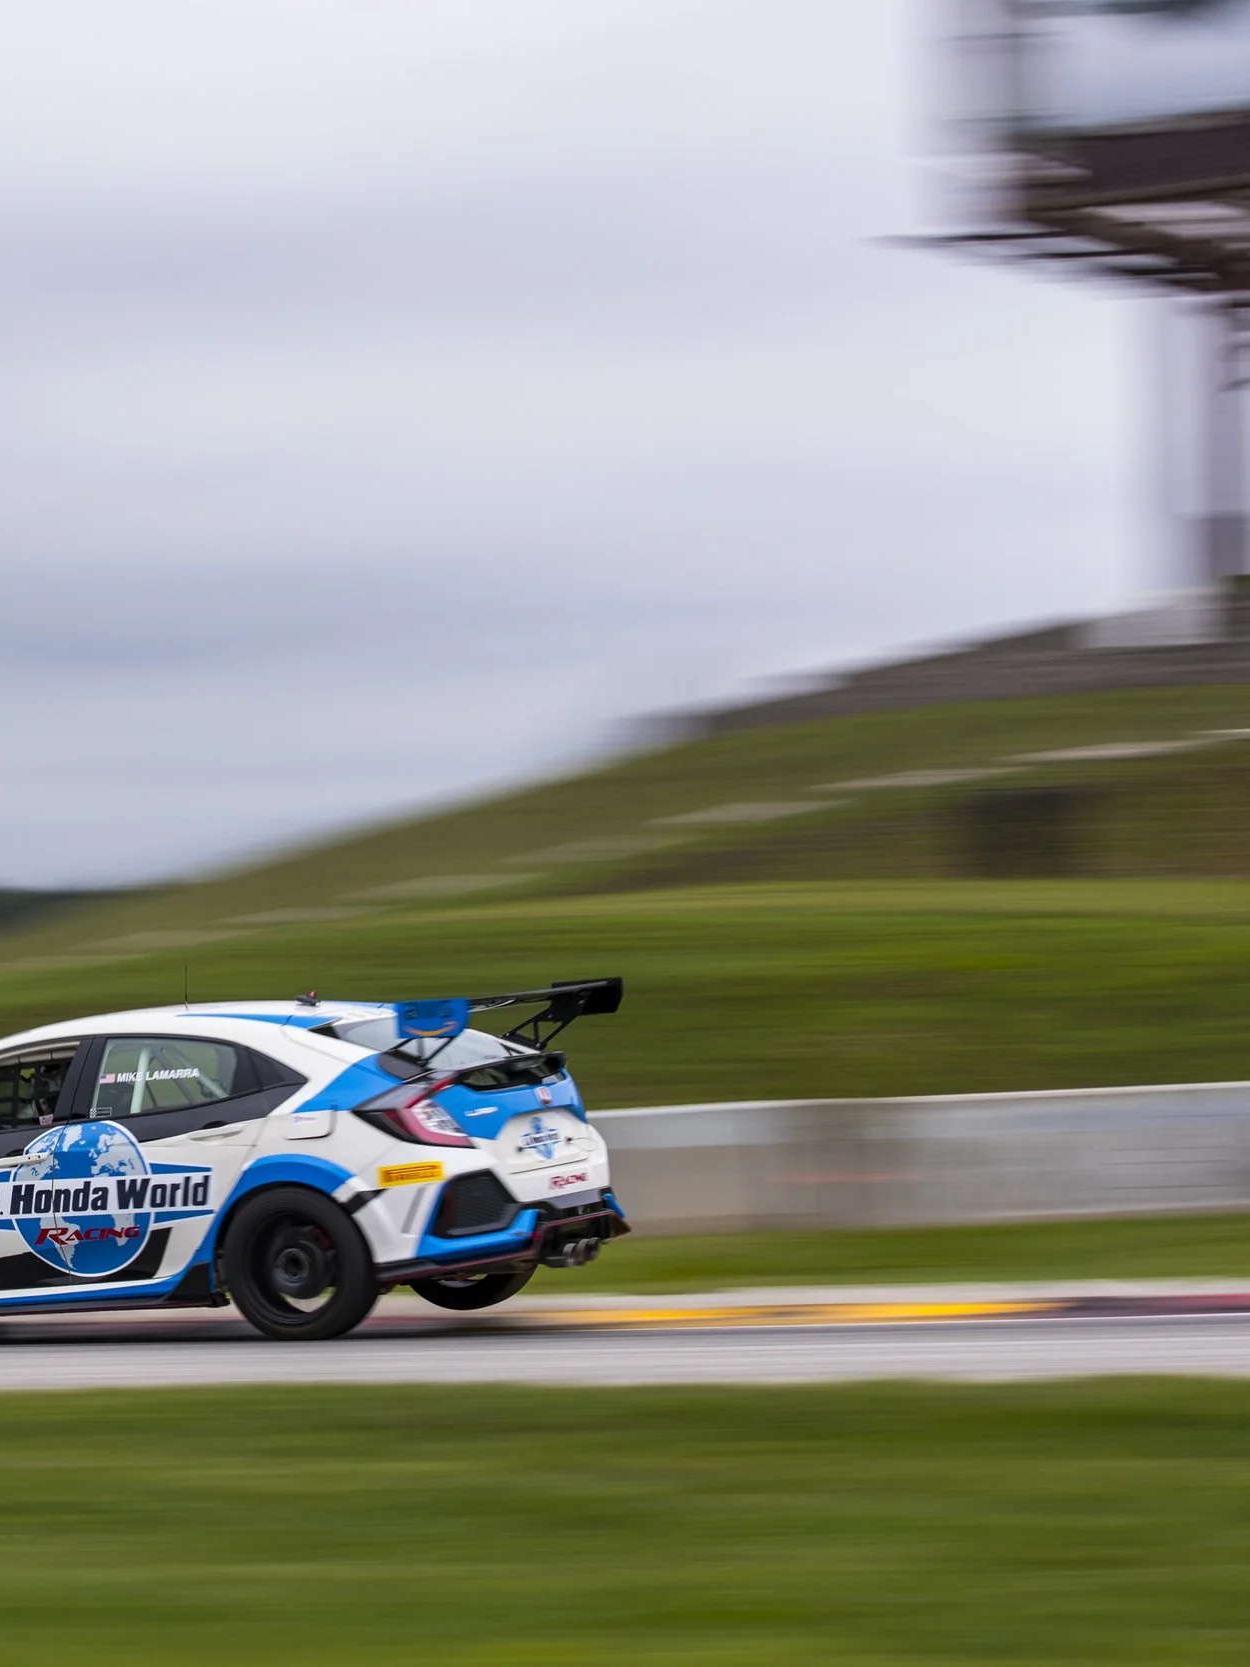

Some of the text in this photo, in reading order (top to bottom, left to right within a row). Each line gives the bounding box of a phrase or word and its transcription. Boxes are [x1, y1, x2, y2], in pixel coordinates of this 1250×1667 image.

[117, 1067, 200, 1083] MIKE LAMARRA
[9, 1181, 110, 1215] Honda
[116, 1174, 211, 1210] World
[34, 1226, 141, 1246] RACING
